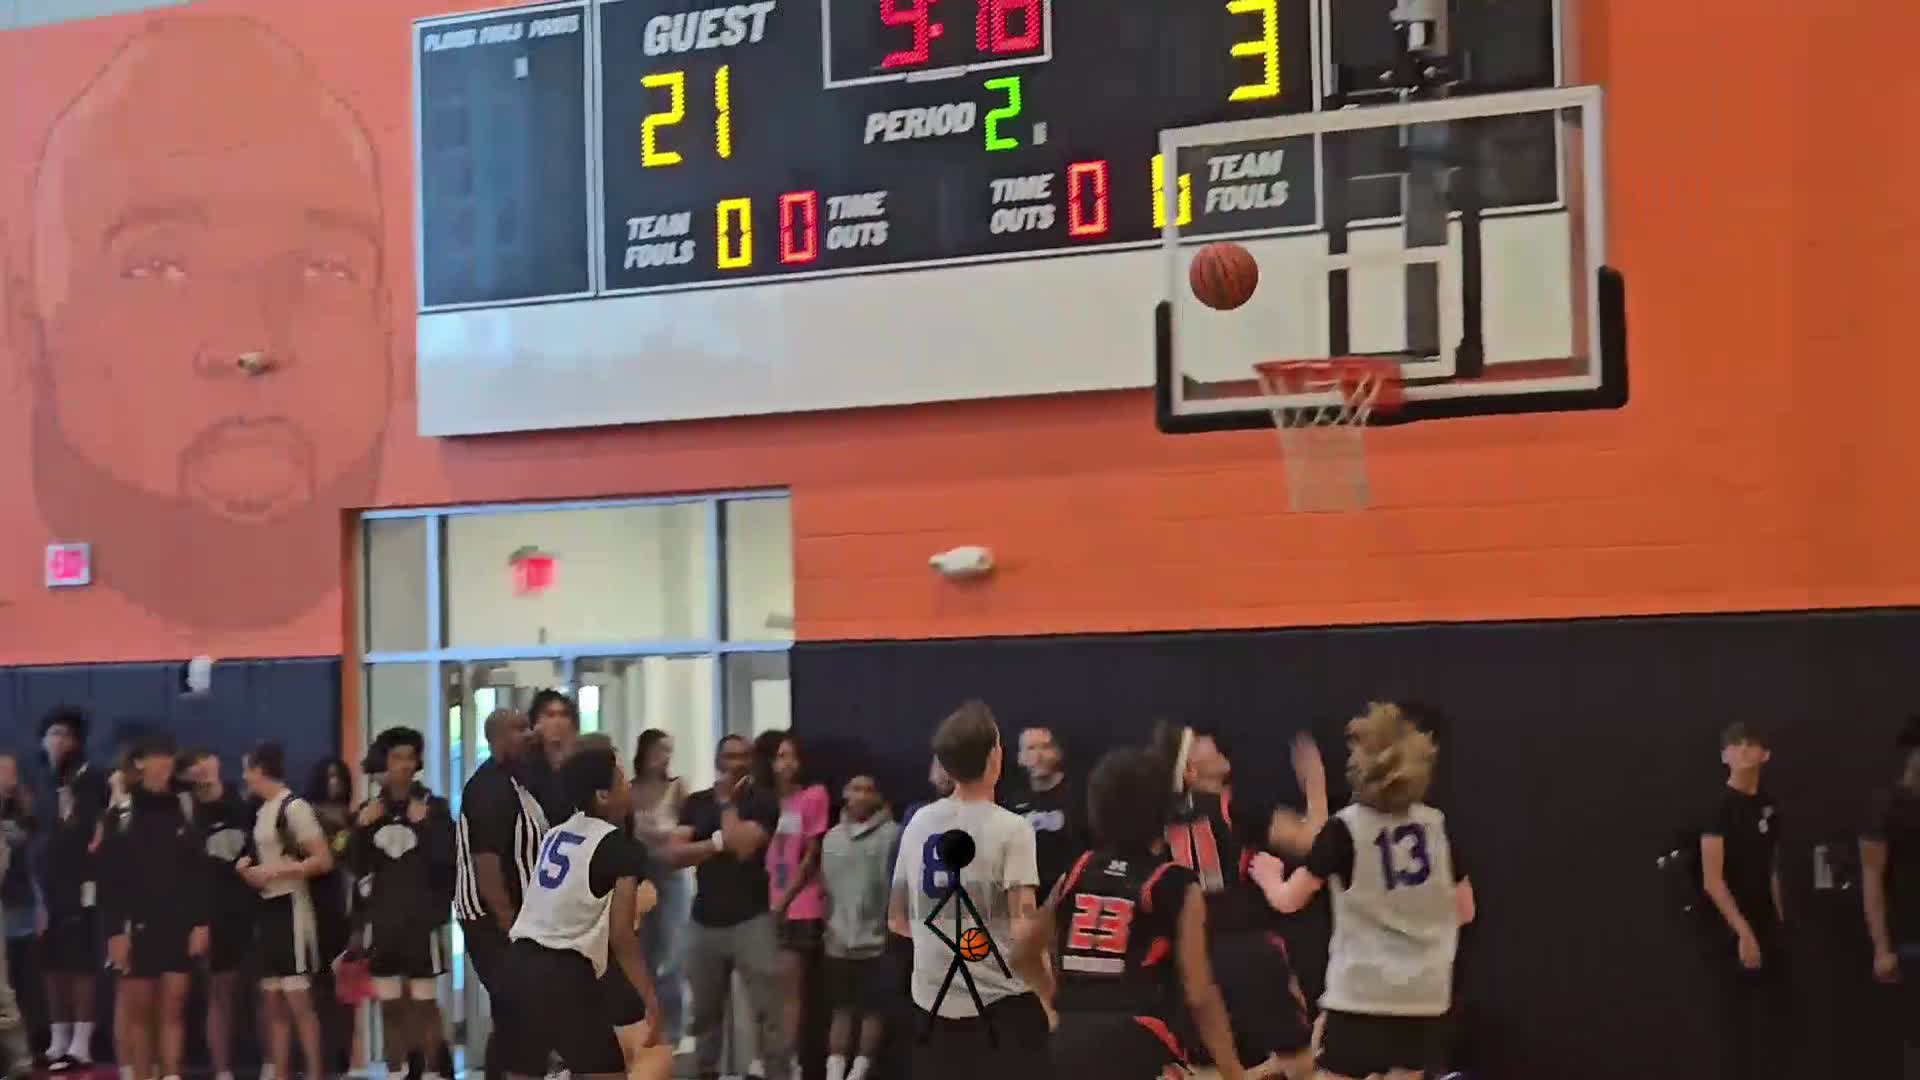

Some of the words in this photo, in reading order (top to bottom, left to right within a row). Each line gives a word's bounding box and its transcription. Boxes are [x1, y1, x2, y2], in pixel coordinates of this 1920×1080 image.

[643, 1, 776, 57] GUEST
[641, 64, 730, 168] 21
[864, 101, 976, 145] PERIOD
[984, 76, 1022, 151] 2
[990, 173, 1055, 205] TIME
[1207, 149, 1284, 182] TEAM
[826, 190, 888, 221] TIME
[990, 203, 1057, 234] OUTS
[1067, 160, 1108, 237] 0
[1204, 180, 1289, 216] FOULS
[626, 212, 691, 241] TEAM
[717, 197, 752, 269] 0
[779, 190, 818, 265] 0
[826, 220, 890, 250] OUTS
[624, 240, 696, 269] FOULS
[539, 828, 586, 889] 15
[1374, 822, 1430, 890] 13
[1067, 893, 1135, 954] 23
